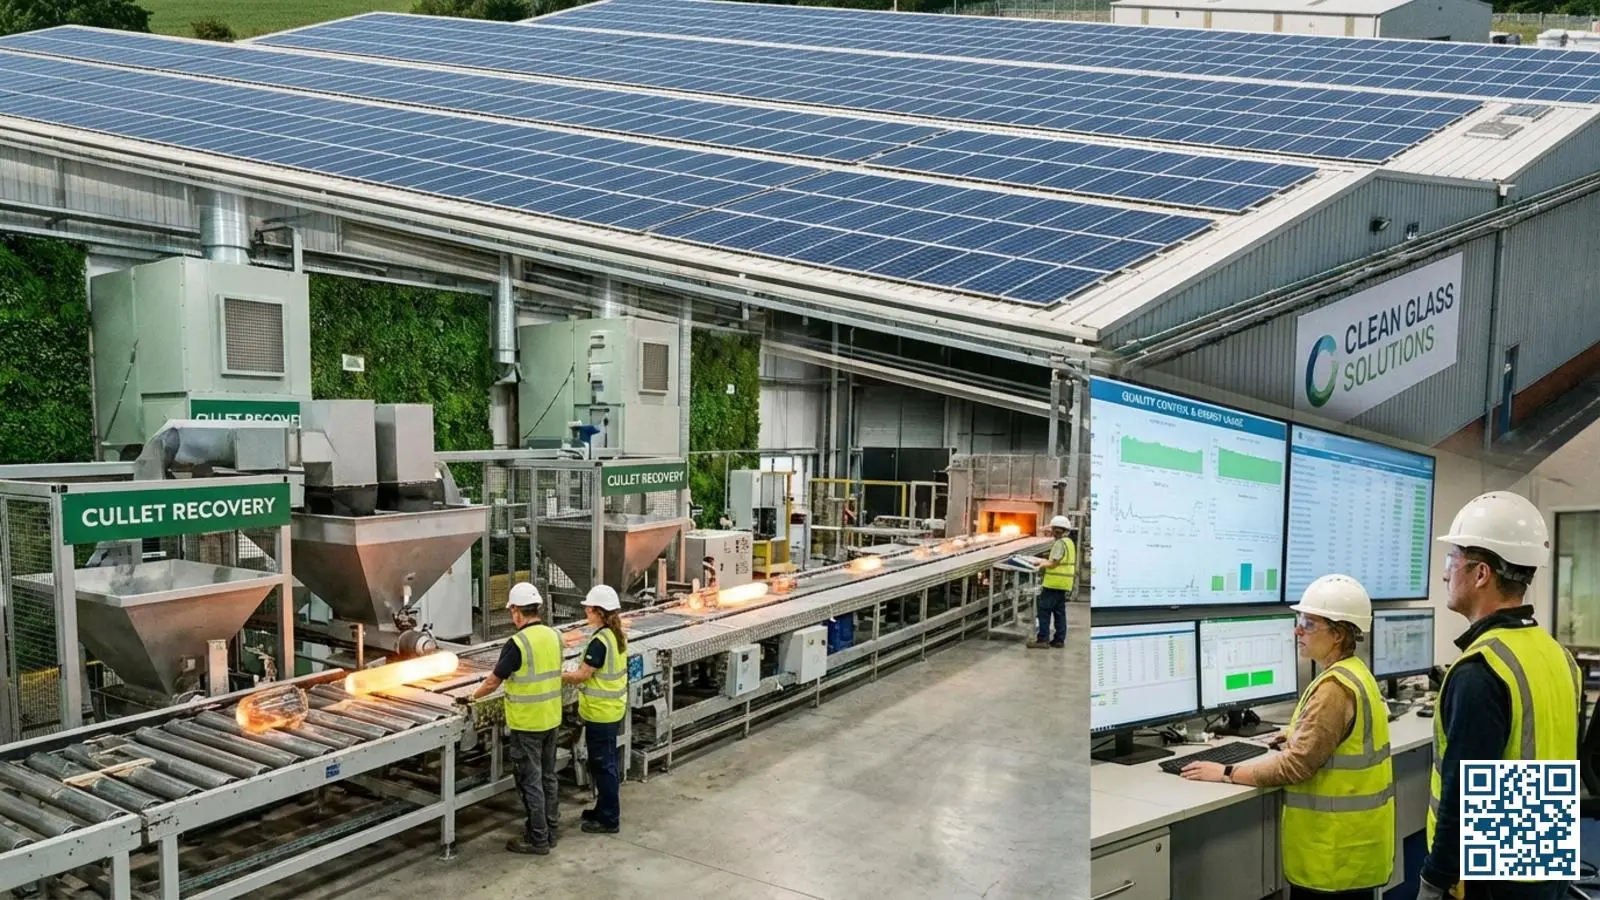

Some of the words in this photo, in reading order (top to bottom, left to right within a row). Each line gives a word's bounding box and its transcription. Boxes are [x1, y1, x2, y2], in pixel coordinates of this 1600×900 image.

[1345, 305, 1401, 354] CLEAN
[1405, 282, 1454, 327] GLASS
[1343, 324, 1435, 392] SOLUTIONS
[607, 473, 640, 486] CULLET
[641, 470, 684, 484] RECOVERY
[81, 504, 166, 527] CULLET
[172, 496, 276, 521] RECOVERY
